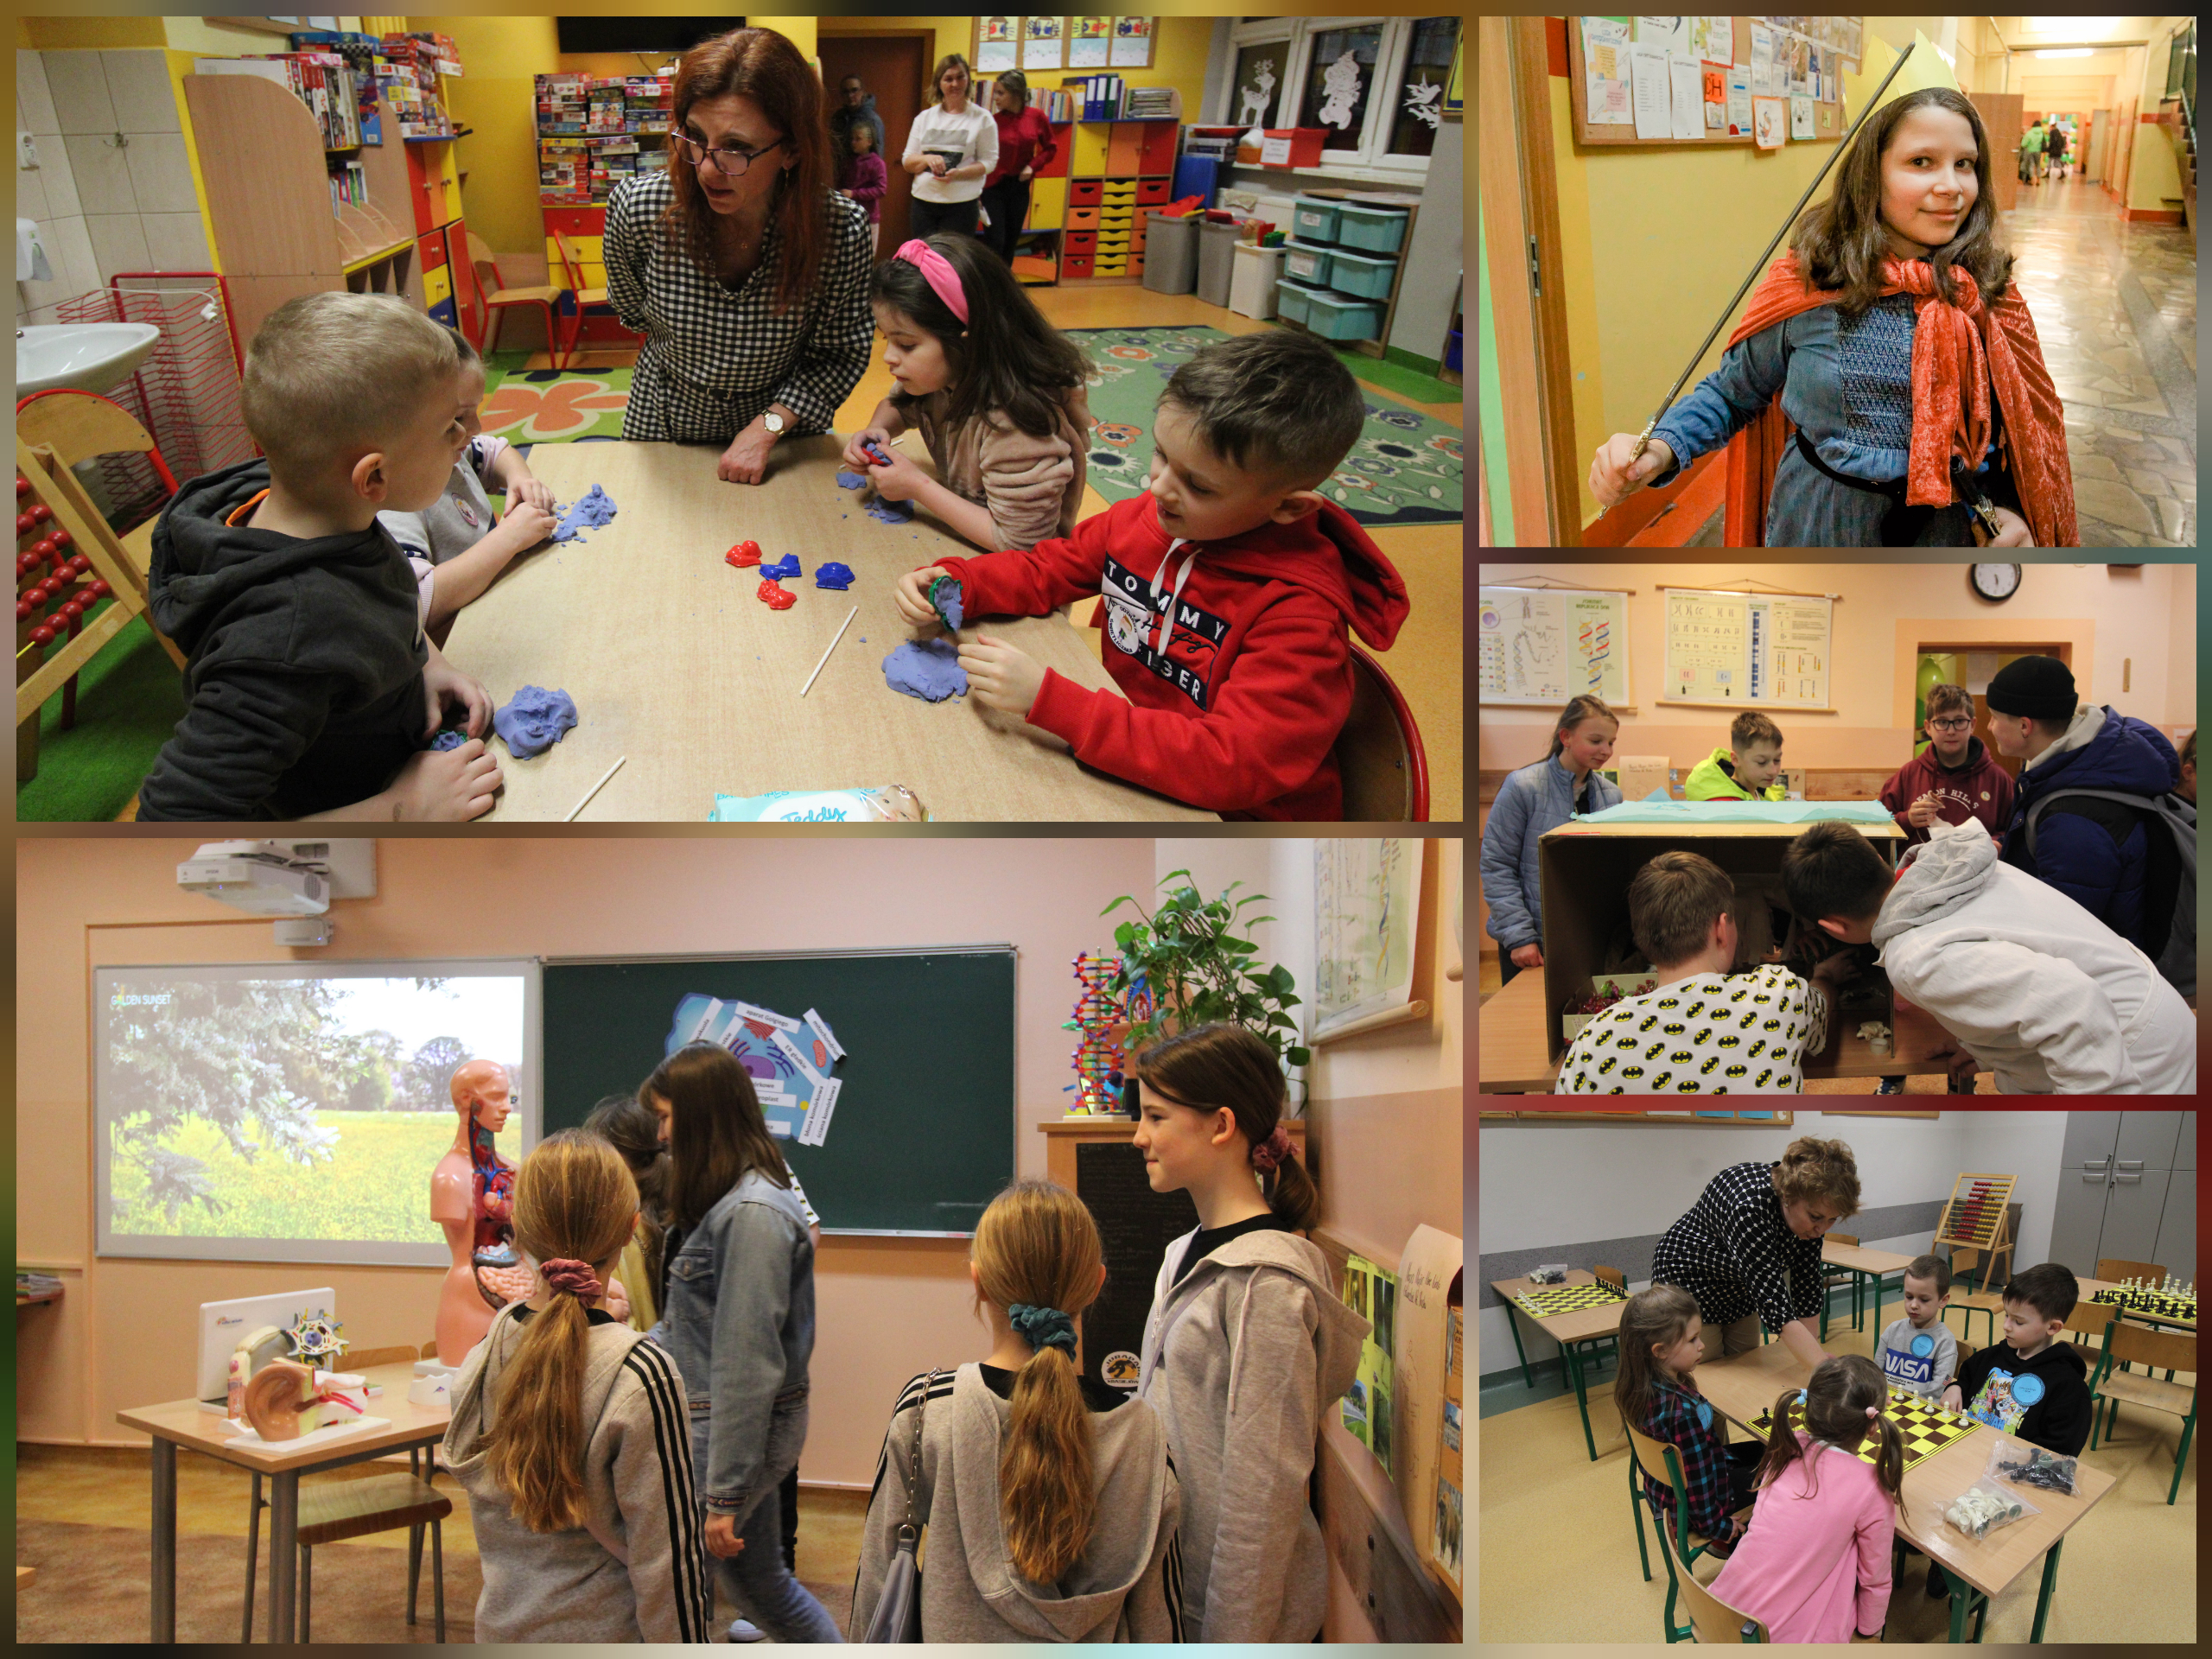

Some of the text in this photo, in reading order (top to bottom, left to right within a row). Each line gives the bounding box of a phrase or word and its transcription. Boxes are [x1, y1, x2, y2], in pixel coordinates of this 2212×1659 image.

[142, 994, 172, 1005] SUNSET
[746, 1009, 789, 1027] aparat Golgiego
[695, 1019, 709, 1039] akuola
[785, 1045, 792, 1053] ER
[809, 1085, 824, 1120] komórkowa
[822, 1085, 836, 1120] komórkowa
[1885, 1352, 1929, 1382] NASA
